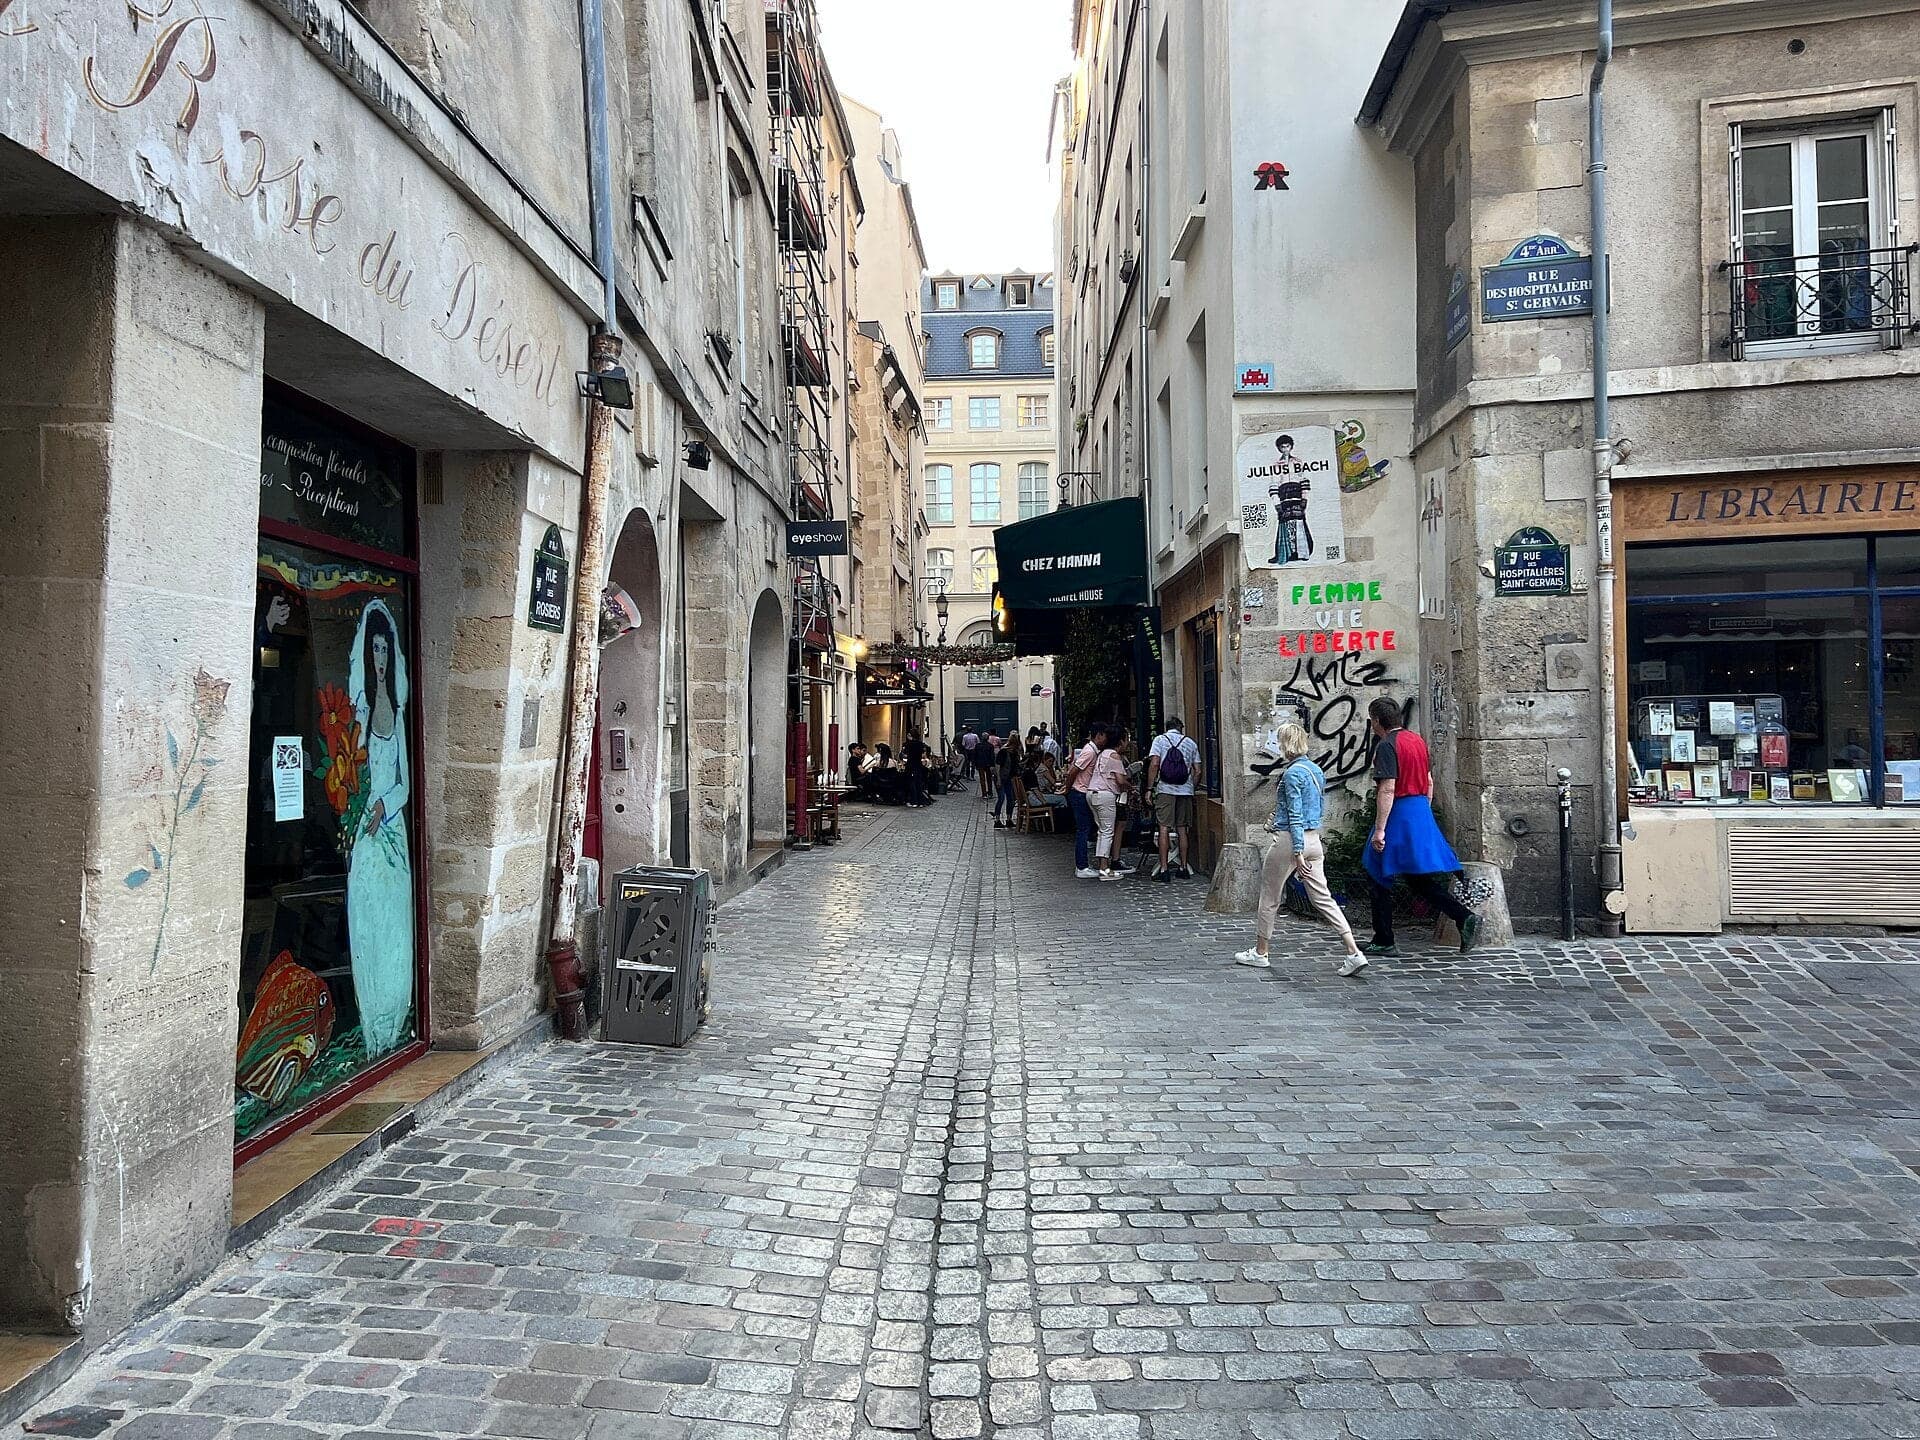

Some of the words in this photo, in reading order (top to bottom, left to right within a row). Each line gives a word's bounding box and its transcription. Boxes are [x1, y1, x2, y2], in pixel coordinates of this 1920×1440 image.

[358, 229, 414, 311] du
[1528, 269, 1559, 282] RUE
[1486, 288, 1507, 299] DES
[1246, 464, 1290, 479] JULIUS
[1294, 460, 1329, 474] BACH
[1665, 480, 1920, 522] LIBRAIRIE
[791, 532, 843, 545] eyeshow
[1022, 556, 1054, 572] CHEZ
[1057, 552, 1102, 569] HANNA
[1523, 551, 1542, 561] RUE
[545, 566, 558, 584] RUE
[1500, 566, 1565, 579] HOSPITALIÈRES
[1501, 577, 1563, 589] SAINT-GERVAIS
[1078, 588, 1104, 601] HOUSE
[1291, 581, 1383, 605] FEMME
[535, 600, 561, 620] ROSIERS
[1316, 608, 1363, 629] VIE
[1279, 630, 1397, 658] LIBERTE
